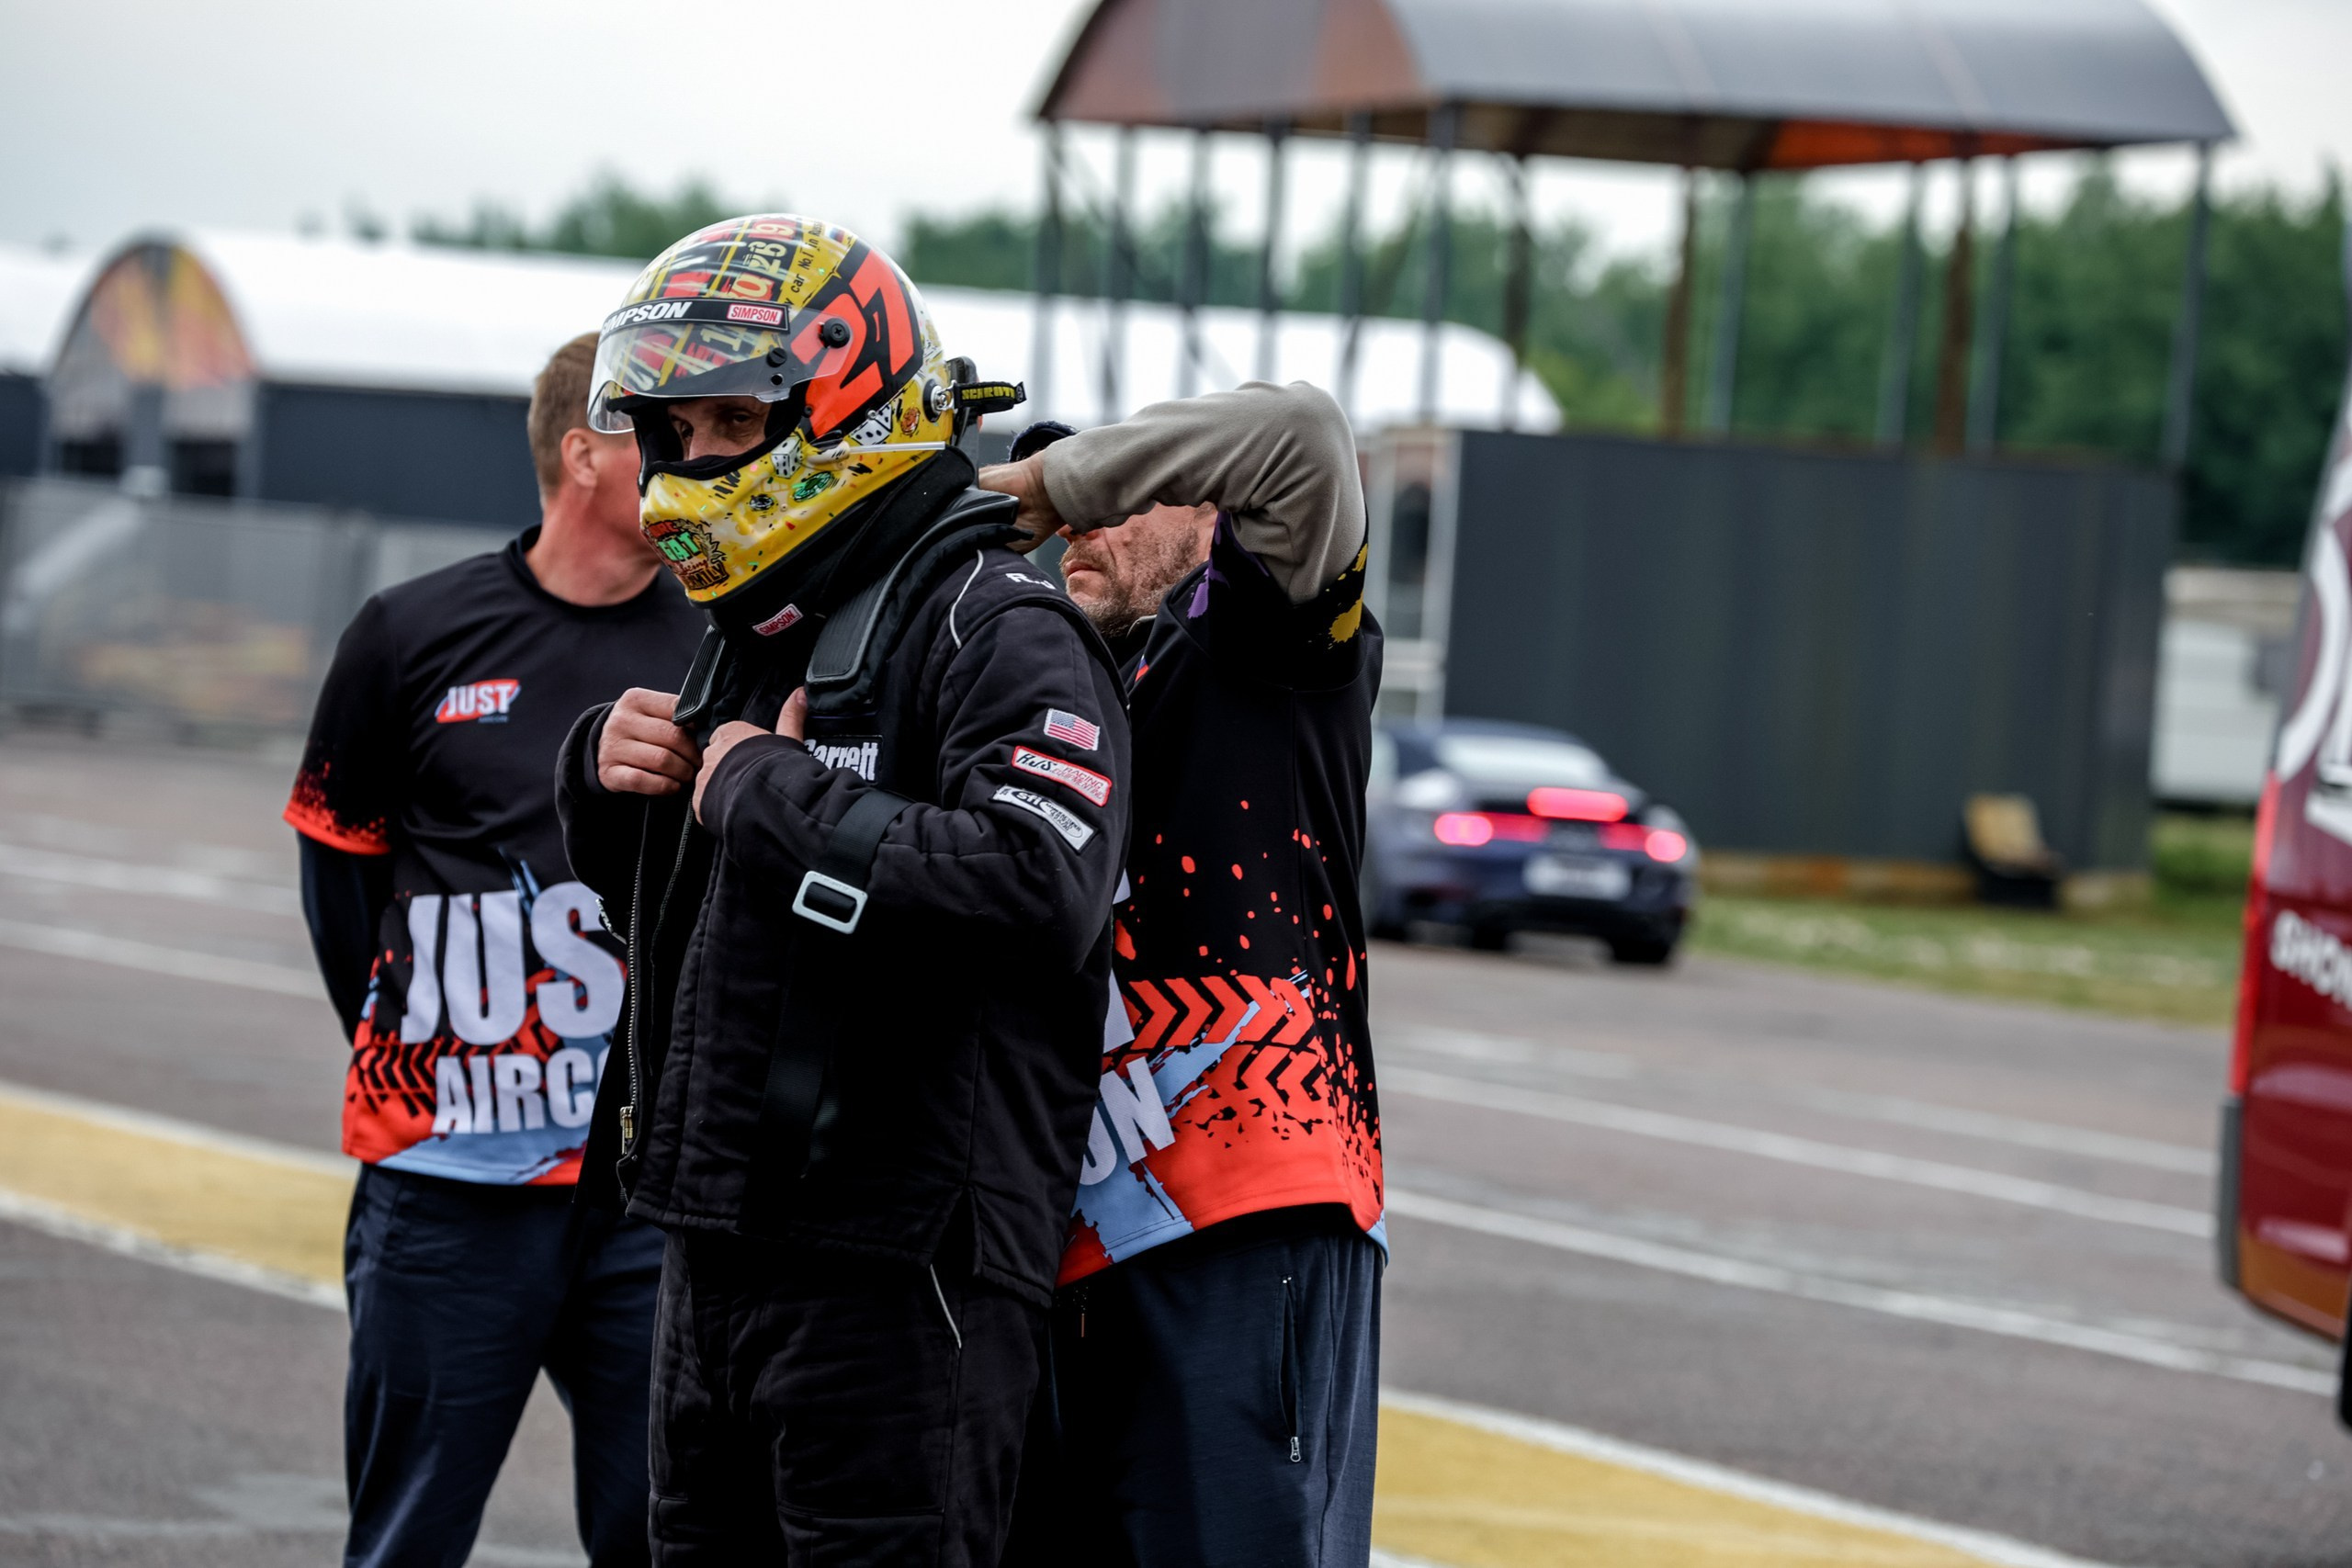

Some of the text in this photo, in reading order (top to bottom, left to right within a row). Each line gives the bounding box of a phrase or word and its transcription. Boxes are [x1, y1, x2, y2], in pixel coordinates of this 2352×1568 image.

[790, 274, 805, 293] car
[808, 238, 820, 249] in
[602, 301, 693, 334] SIMPSON
[731, 307, 779, 322] SIMPSON
[790, 249, 915, 440] 27
[759, 610, 797, 635] SIMPSON
[446, 683, 512, 717] JUST
[1063, 767, 1104, 790] RACING
[432, 1048, 607, 1134] AIRC
